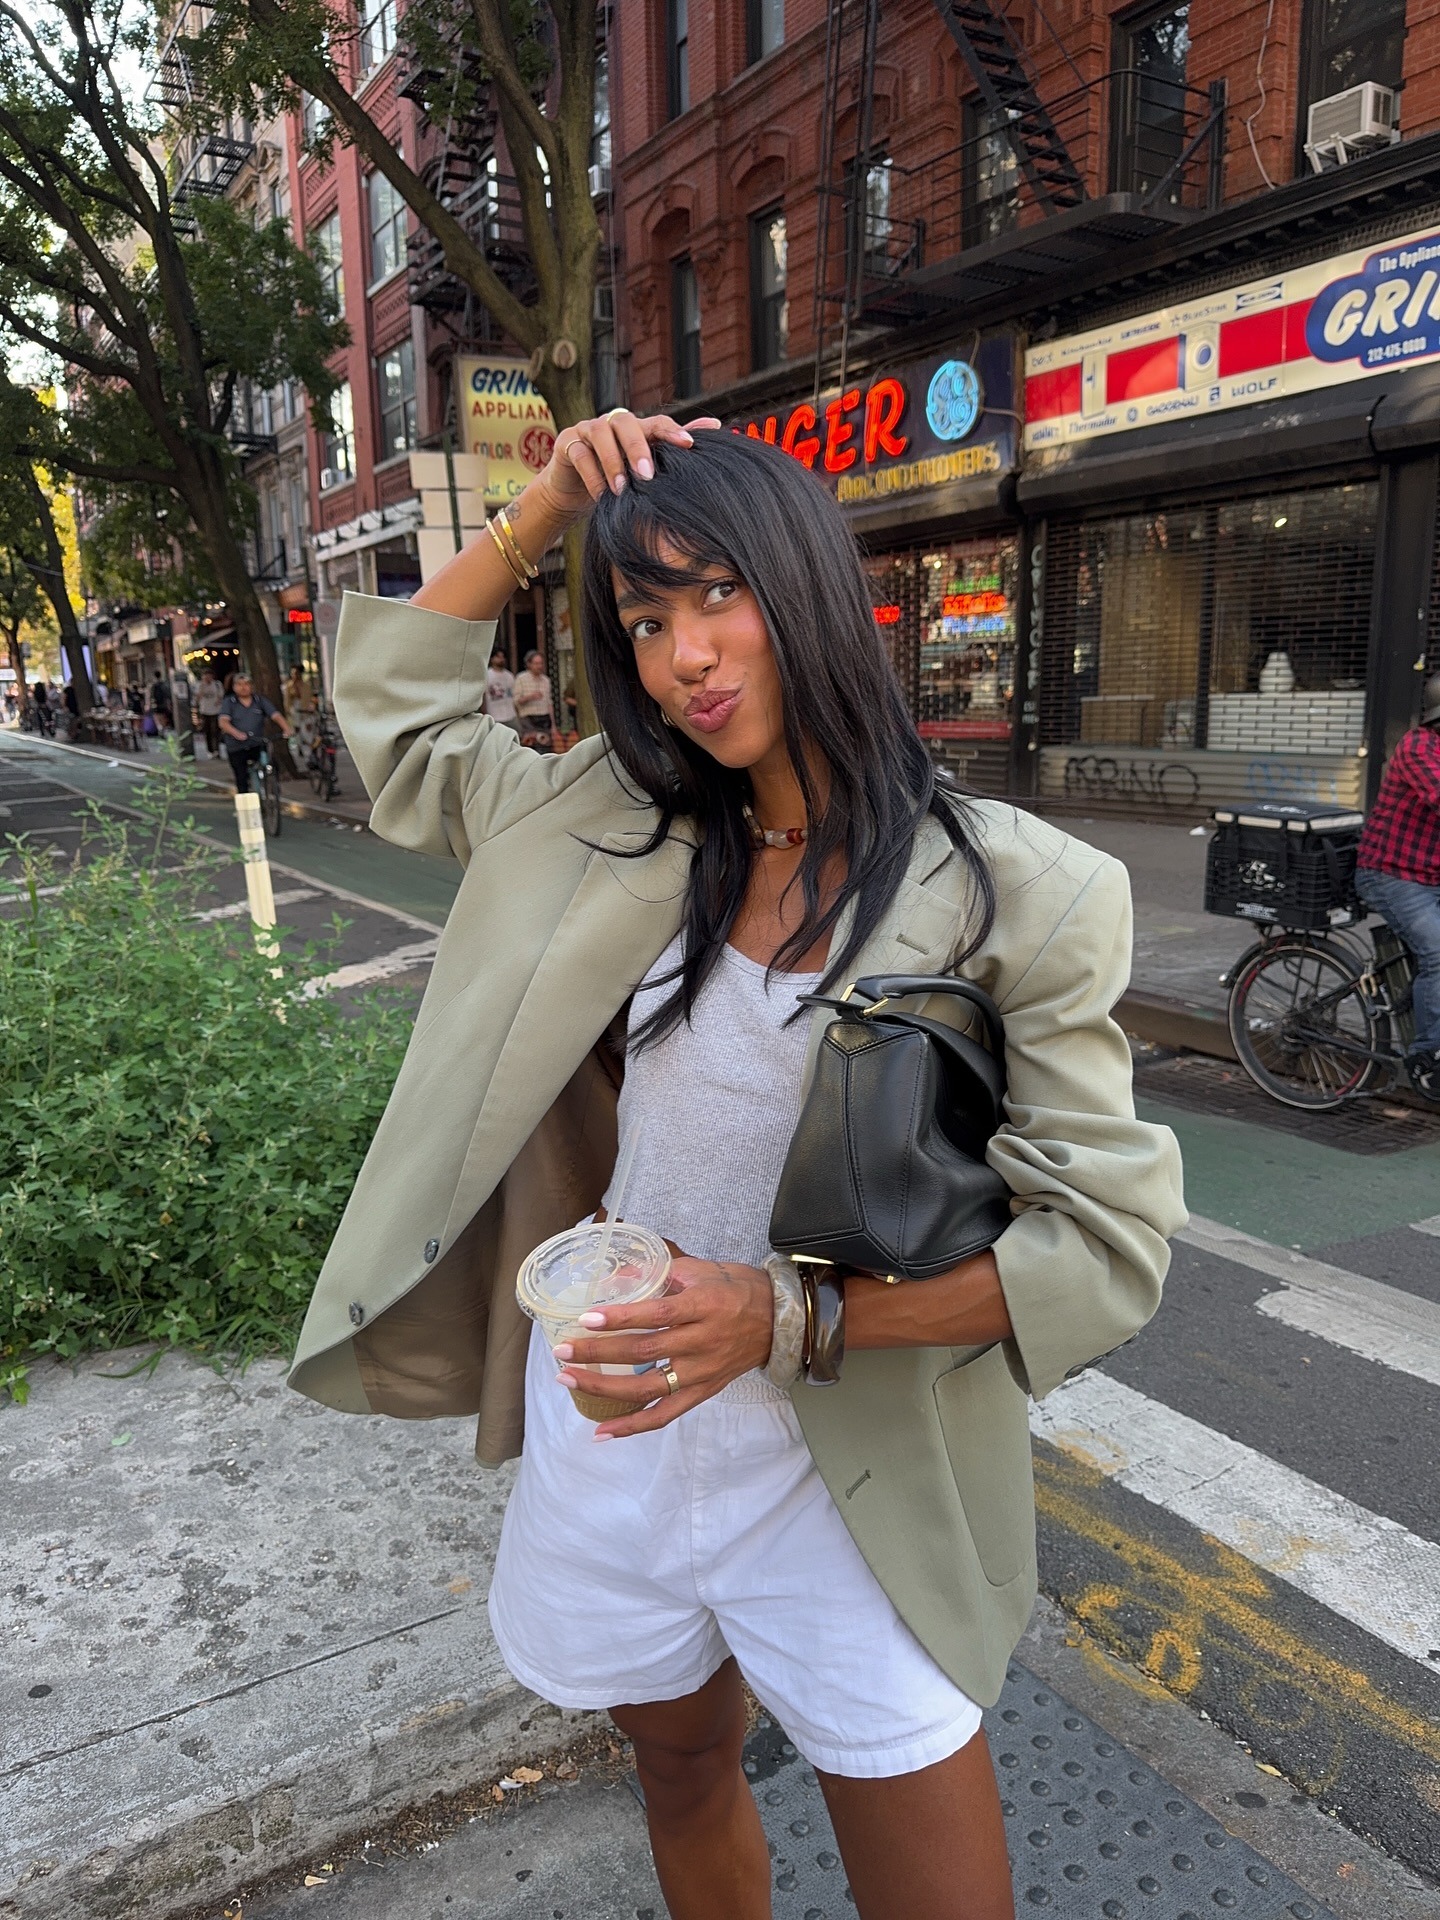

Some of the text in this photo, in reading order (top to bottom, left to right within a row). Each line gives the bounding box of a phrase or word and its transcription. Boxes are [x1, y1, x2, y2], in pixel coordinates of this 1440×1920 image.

[1379, 256, 1398, 273] The
[1230, 377, 1278, 398] WOLF
[473, 441, 514, 461] COLOR
[594, 1242, 644, 1269] CPOSTABLE
